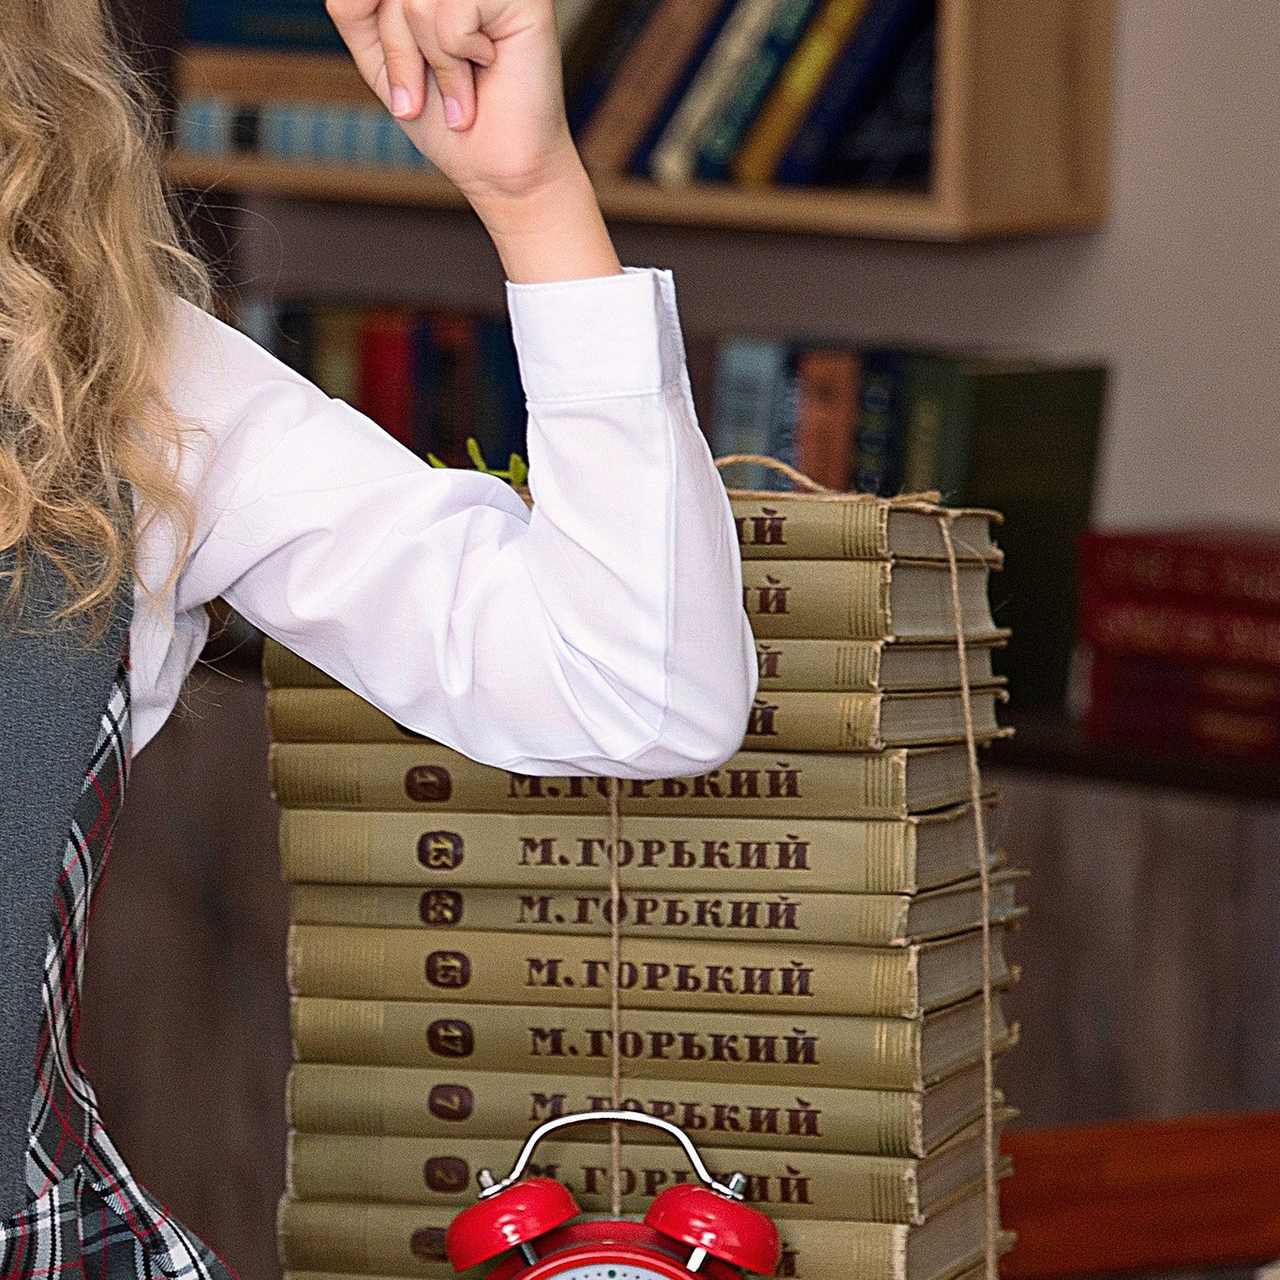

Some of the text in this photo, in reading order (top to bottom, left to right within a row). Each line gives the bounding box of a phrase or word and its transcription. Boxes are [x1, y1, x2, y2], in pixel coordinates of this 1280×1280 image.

[429, 836, 454, 868] 13
[518, 835, 811, 871] М.ГОРЬКИЙ
[518, 895, 801, 930] М.ГОРЬКИЙ
[437, 956, 462, 985] 15
[525, 958, 815, 997] М.ГОРЬКИЙ
[528, 1026, 820, 1065] М.ГОРЬКИЙ
[436, 1095, 460, 1111] 7
[529, 1092, 822, 1137] МГРЬКИЙ
[523, 1164, 812, 1205] .ГОРИЙ
